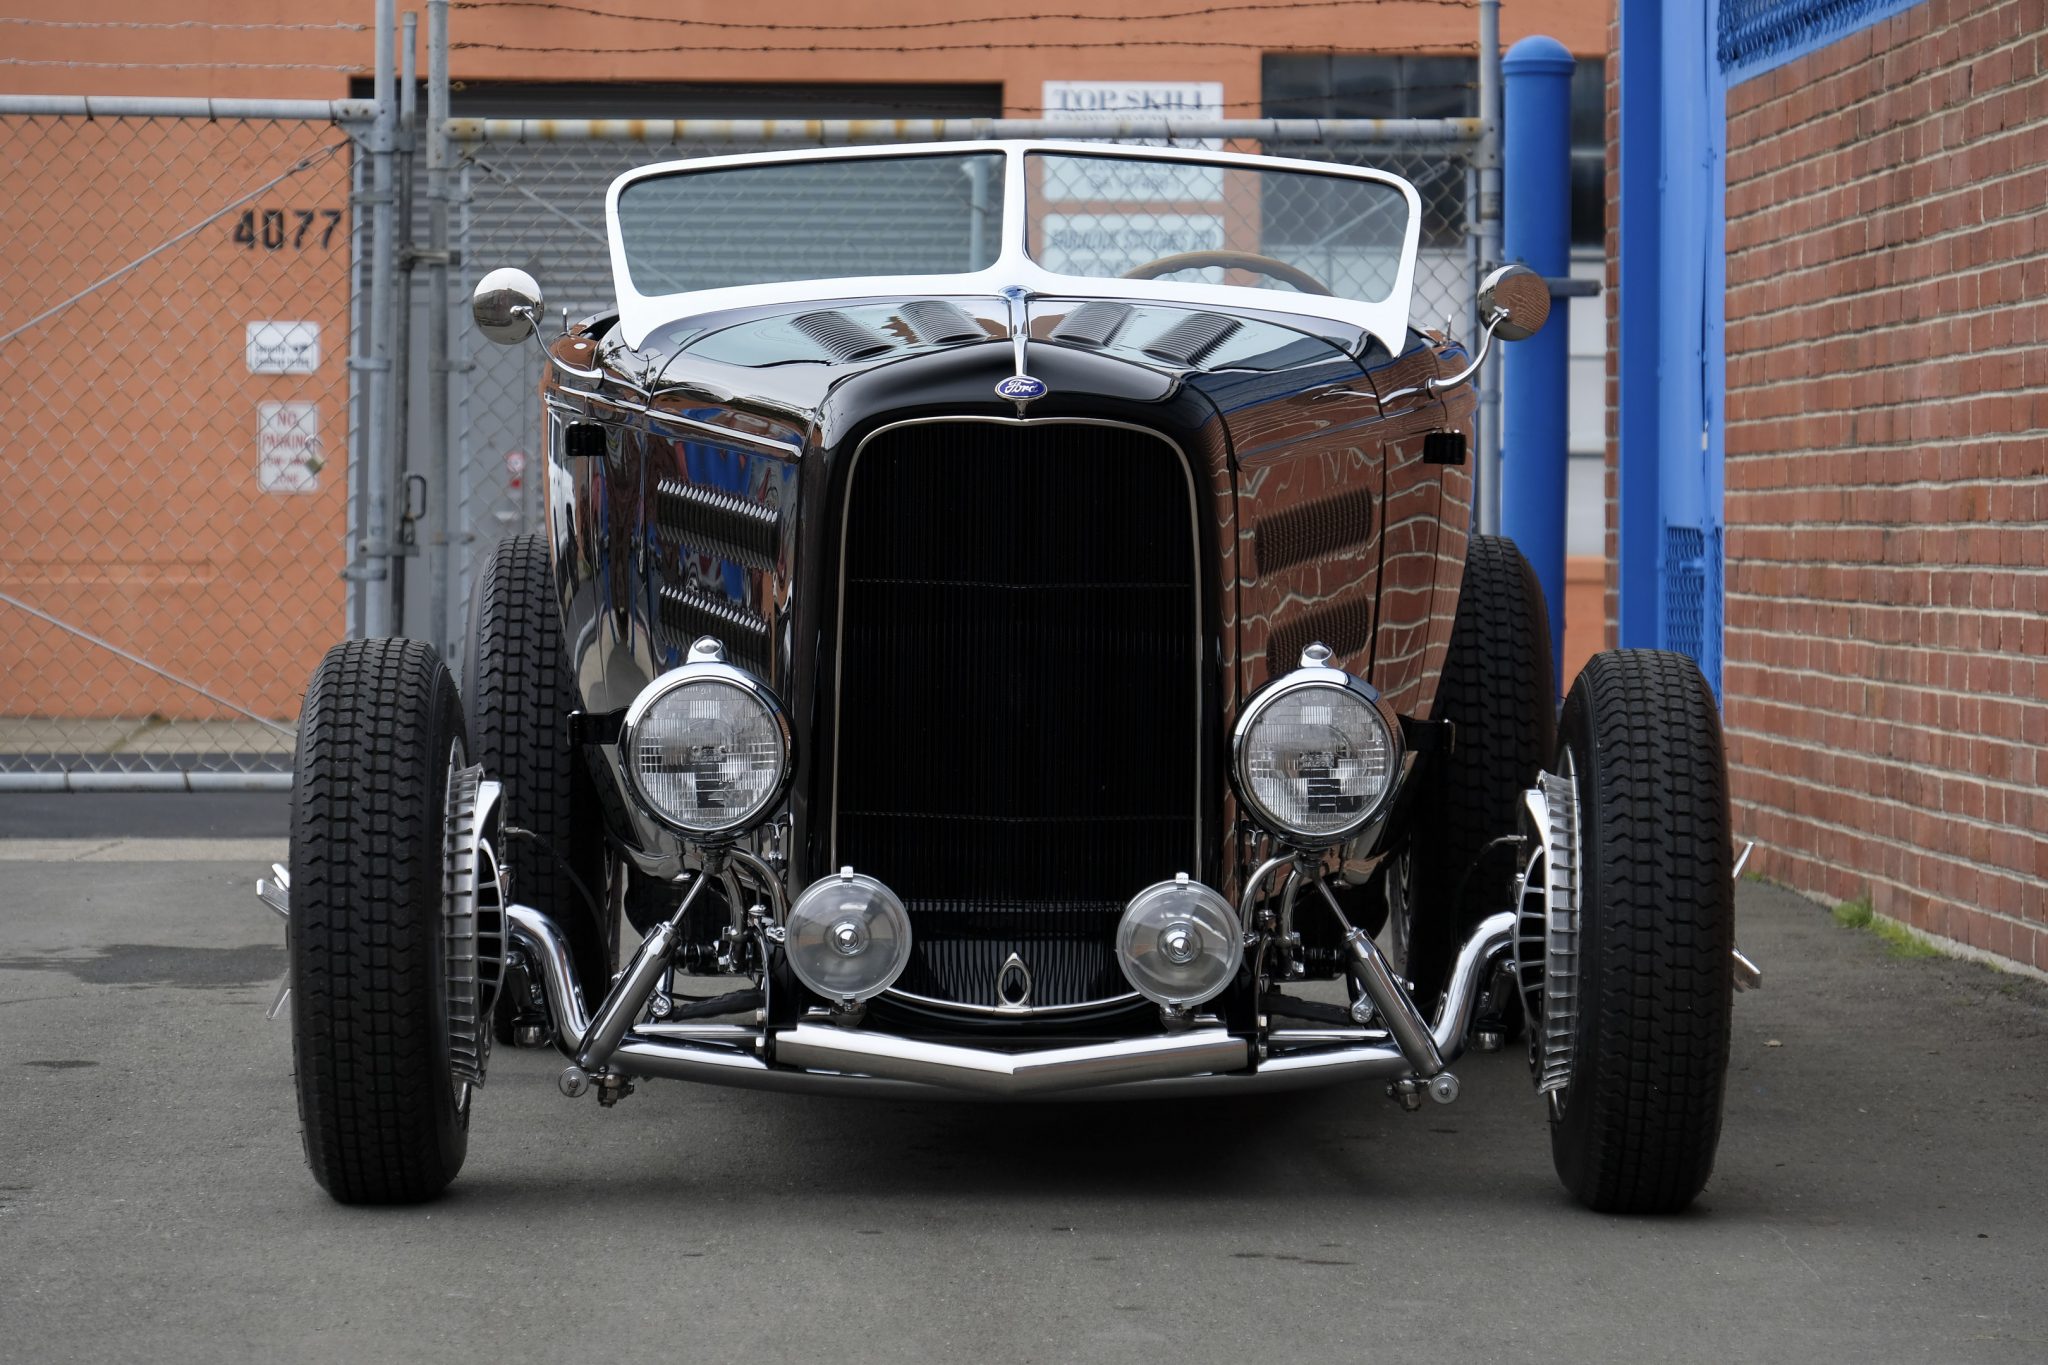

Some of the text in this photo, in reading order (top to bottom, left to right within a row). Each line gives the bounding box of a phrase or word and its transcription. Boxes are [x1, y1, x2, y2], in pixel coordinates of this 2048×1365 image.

[1054, 89, 1213, 110] TOP SKILL
[234, 209, 342, 249] 4077
[1004, 380, 1039, 394] Ford
[277, 412, 297, 428] NO
